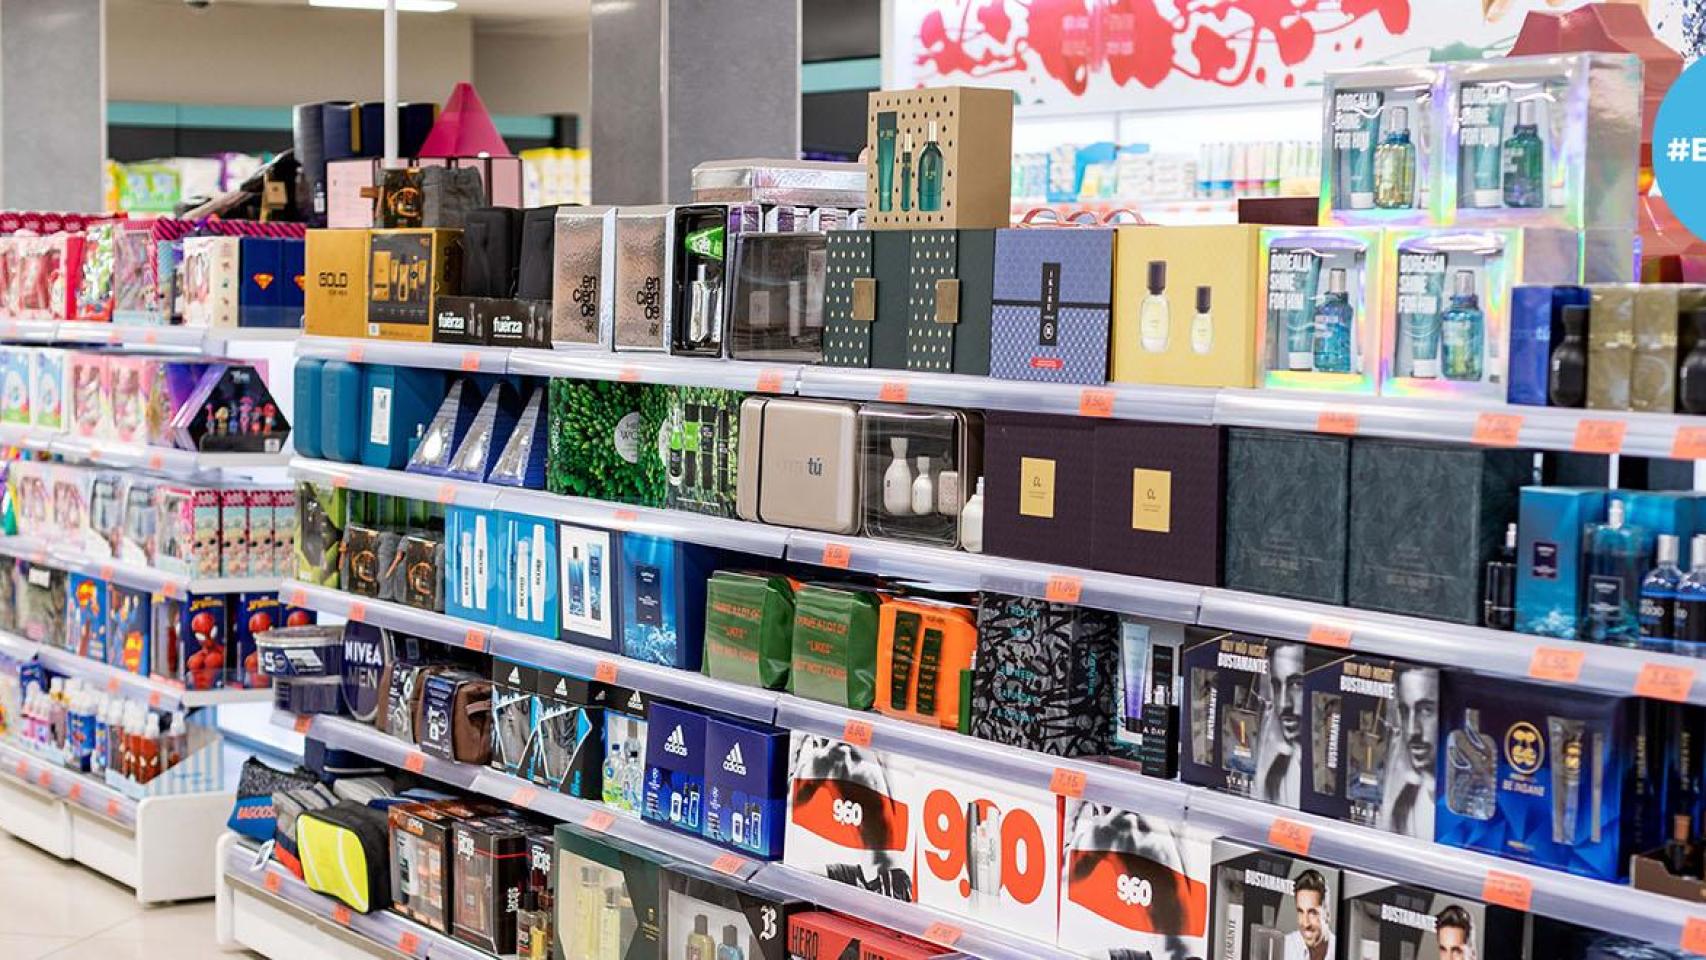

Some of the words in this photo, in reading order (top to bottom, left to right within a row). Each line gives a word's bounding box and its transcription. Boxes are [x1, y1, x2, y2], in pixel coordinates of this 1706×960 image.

[319, 271, 348, 288] GOLD
[438, 313, 464, 330] fuerza
[493, 317, 522, 334] fuerza
[807, 457, 822, 475] tú
[345, 641, 382, 666] NIVEA
[1218, 653, 1269, 674] BUSTAMANTE
[1340, 675, 1395, 699] BUSTAMANTE
[664, 742, 688, 757] adidas
[722, 760, 747, 776] adidas
[923, 789, 1046, 904] 9,0
[1116, 874, 1153, 907] 9,60
[1244, 869, 1296, 896] BUSTAMANTE
[759, 904, 778, 941] B
[1381, 903, 1438, 933] BUSTAMANTE
[793, 924, 819, 960] HERO
